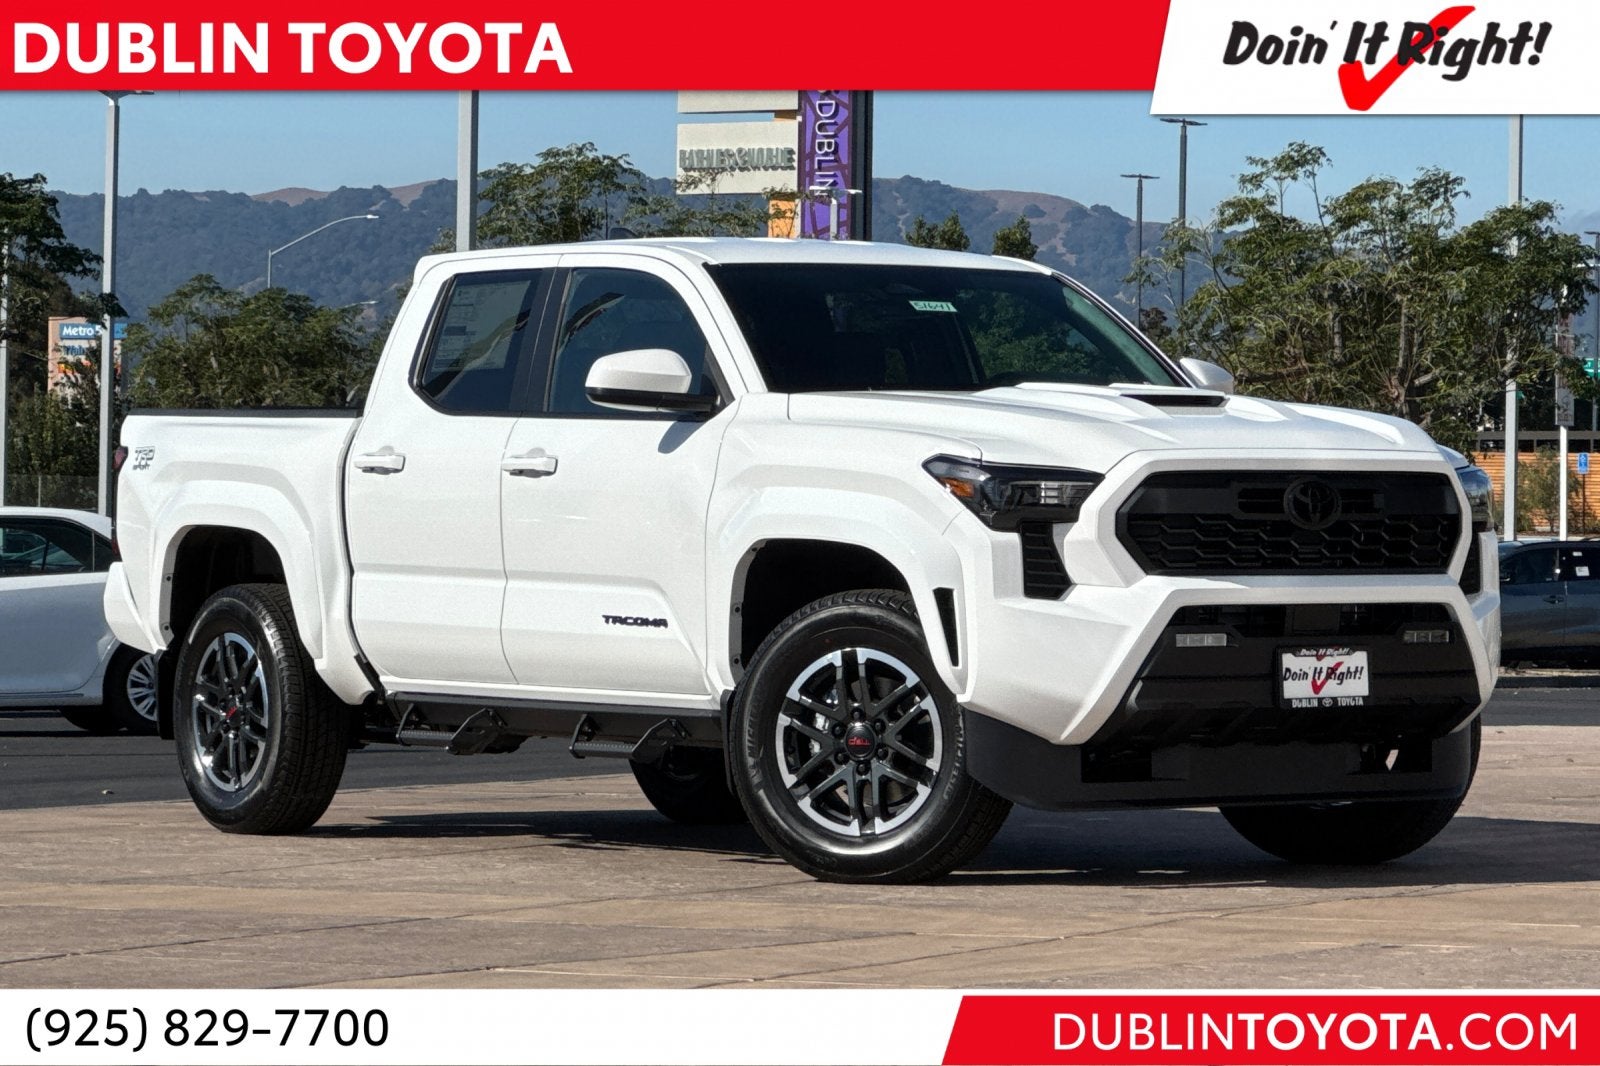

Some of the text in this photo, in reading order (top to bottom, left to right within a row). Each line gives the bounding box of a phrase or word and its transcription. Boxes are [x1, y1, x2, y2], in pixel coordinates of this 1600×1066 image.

[815, 100, 836, 197] DUBLIN
[62, 325, 95, 336] Metro
[601, 614, 668, 629] TACOMA
[1312, 666, 1324, 681] It
[1325, 666, 1364, 685] Right!
[1292, 697, 1364, 708] DUBLIN TOYOTA
